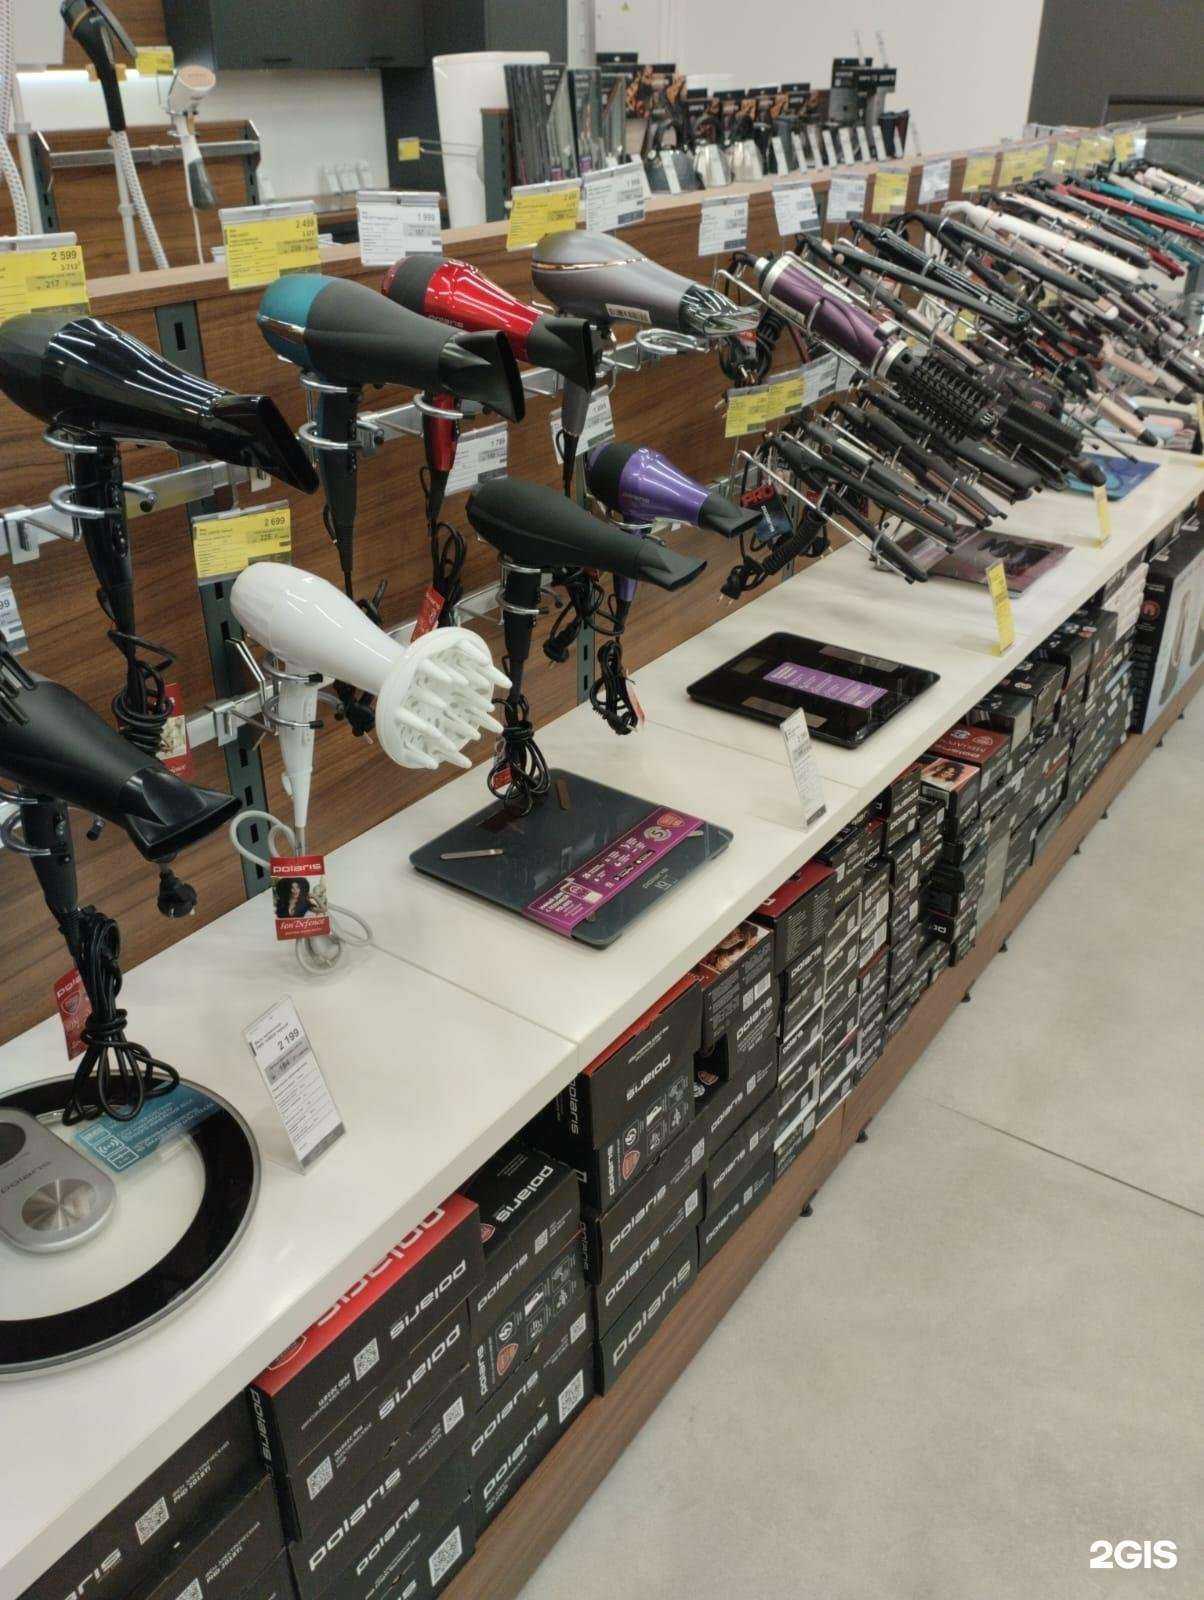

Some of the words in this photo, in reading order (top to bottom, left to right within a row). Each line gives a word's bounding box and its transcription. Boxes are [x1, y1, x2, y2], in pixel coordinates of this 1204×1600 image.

[272, 862, 322, 873] polaris
[495, 1164, 555, 1223] polaris
[609, 1183, 668, 1254] polaris
[389, 1258, 468, 1341] polaris
[605, 1235, 661, 1308] polaris
[612, 1259, 692, 1368] polaris
[378, 1323, 462, 1422] polaris
[470, 1369, 540, 1458] polaris
[482, 1412, 550, 1501] polaris
[309, 1467, 401, 1573] polaris
[355, 1498, 421, 1577] polaris
